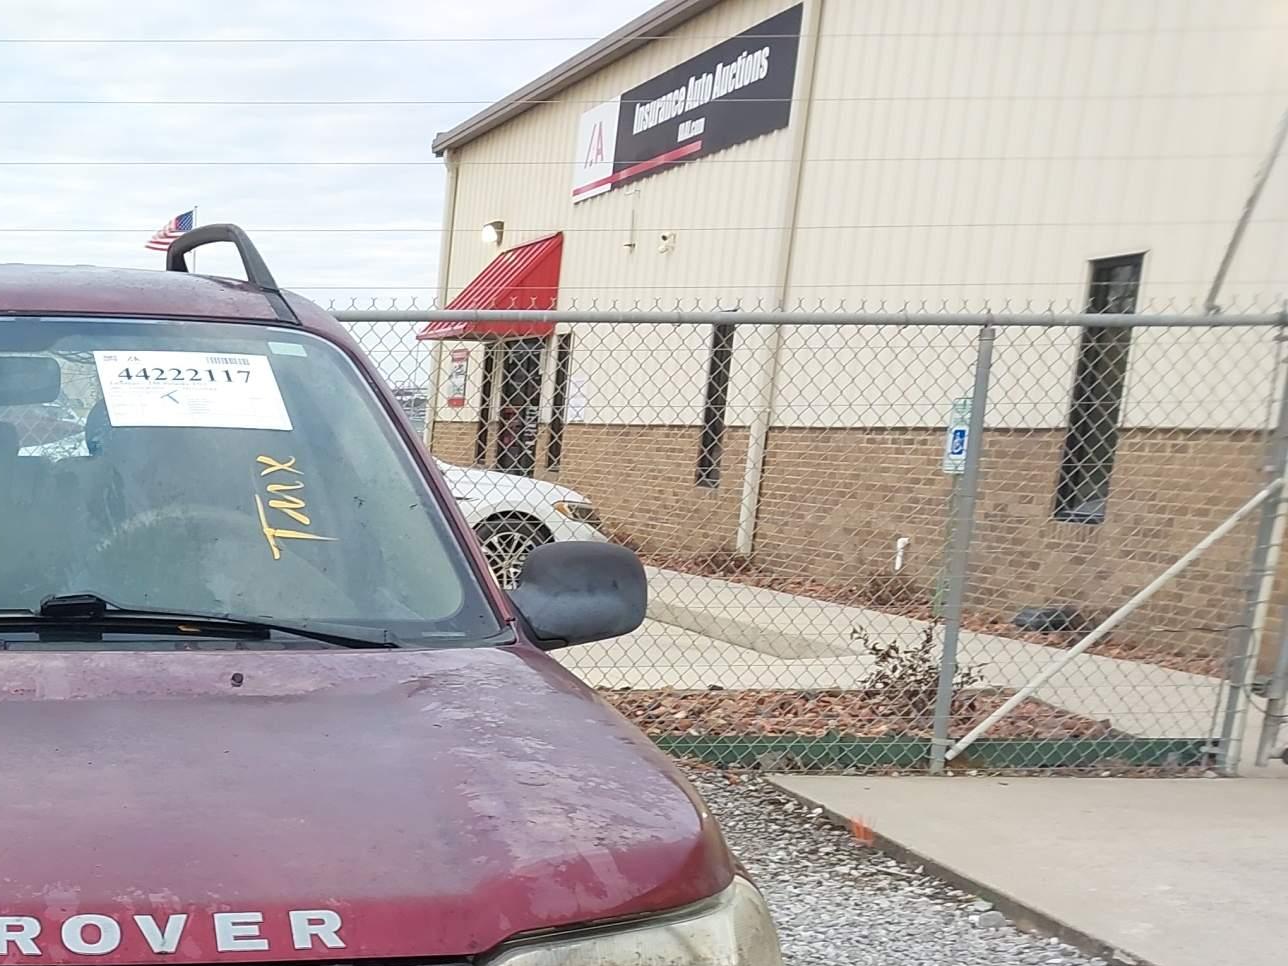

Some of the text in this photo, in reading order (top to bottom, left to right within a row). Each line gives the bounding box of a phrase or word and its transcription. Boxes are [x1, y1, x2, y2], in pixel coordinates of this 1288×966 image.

[632, 86, 687, 135] Insurance
[685, 73, 713, 112] Auto
[712, 46, 770, 100] Auctions
[117, 367, 251, 383] 44222117
